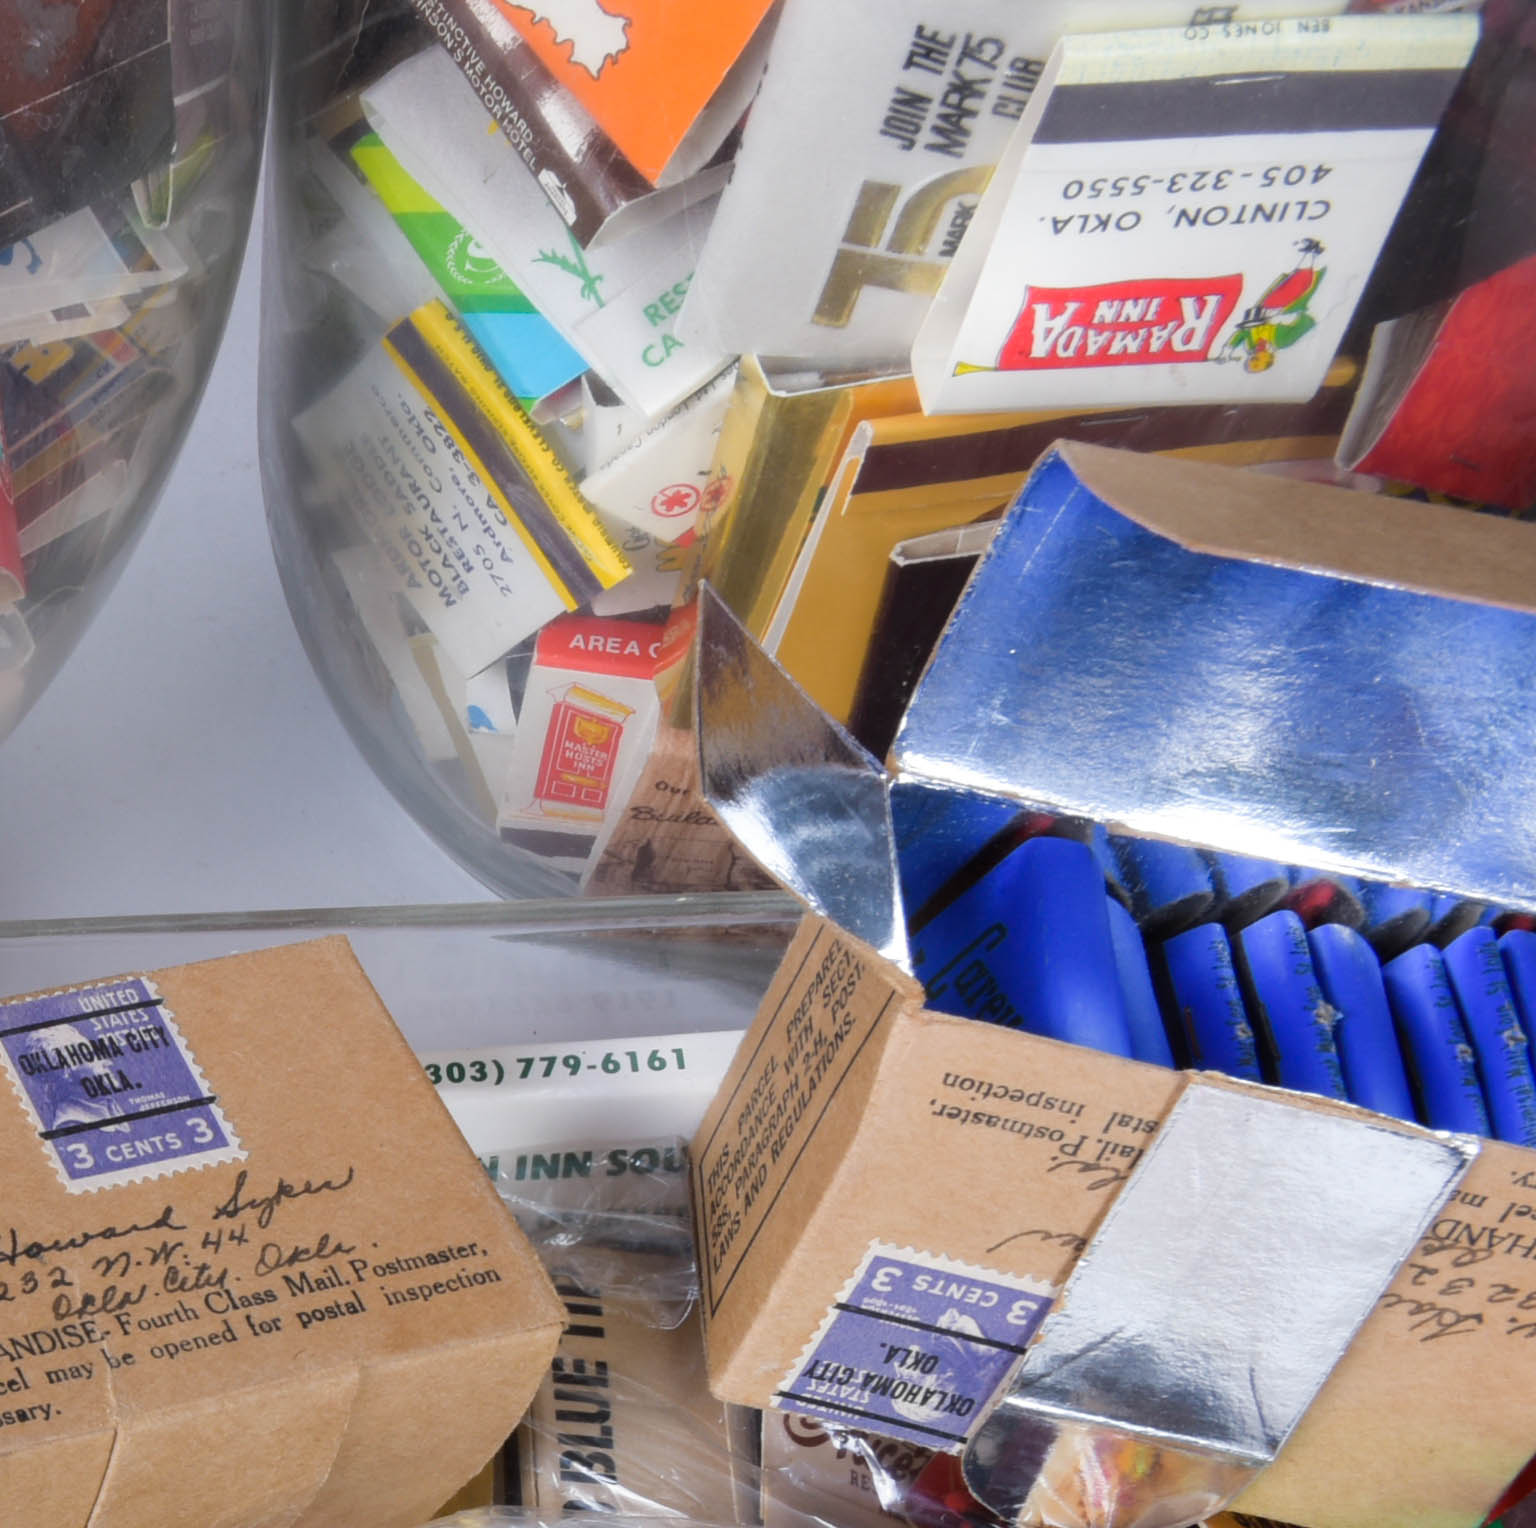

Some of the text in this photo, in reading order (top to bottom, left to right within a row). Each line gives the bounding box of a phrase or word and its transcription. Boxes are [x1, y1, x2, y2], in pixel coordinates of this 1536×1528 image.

[1219, 18, 1332, 40] BEN JONES
[456, 61, 544, 171] MOTOR HOTEL
[479, 75, 540, 143] HOWARD
[872, 17, 962, 156] JOIN THE
[917, 64, 999, 166] MARK
[1051, 199, 1331, 235] CLINTON, OKLA.
[1022, 291, 1226, 360] RAMADA
[1090, 295, 1166, 325] INN
[399, 527, 460, 610] MOTOR
[418, 525, 473, 594] BLACK
[569, 632, 641, 659] AREA
[25, 1021, 170, 1070] OKLAHOMA CITY
[515, 1044, 687, 1082] 779-6161
[80, 1067, 142, 1104] OKLA.
[738, 1055, 777, 1135] PARCEL
[744, 1011, 856, 1215] AND REGULATIONS.
[942, 1072, 1086, 1124] inspection
[67, 1118, 213, 1174] 3 CENTS 3
[701, 1015, 814, 1224] ACCORDANCE WITH
[734, 1074, 799, 1200] PARAGRAPH
[929, 1098, 1089, 1158] Postmaster,
[515, 1147, 592, 1183] INN
[215, 1288, 278, 1315] Class
[349, 1242, 488, 1283] Postmaster,
[871, 1267, 1038, 1330] 3 CENTS 3
[45, 1362, 93, 1385] may
[149, 1319, 239, 1360] opened
[245, 1314, 282, 1337] for
[295, 1290, 366, 1330] postal
[380, 1267, 502, 1306] inspection
[800, 1355, 975, 1417] OKLAHOMA CITY
[880, 1343, 939, 1378] OKLA.
[543, 1358, 621, 1487] BLUE
